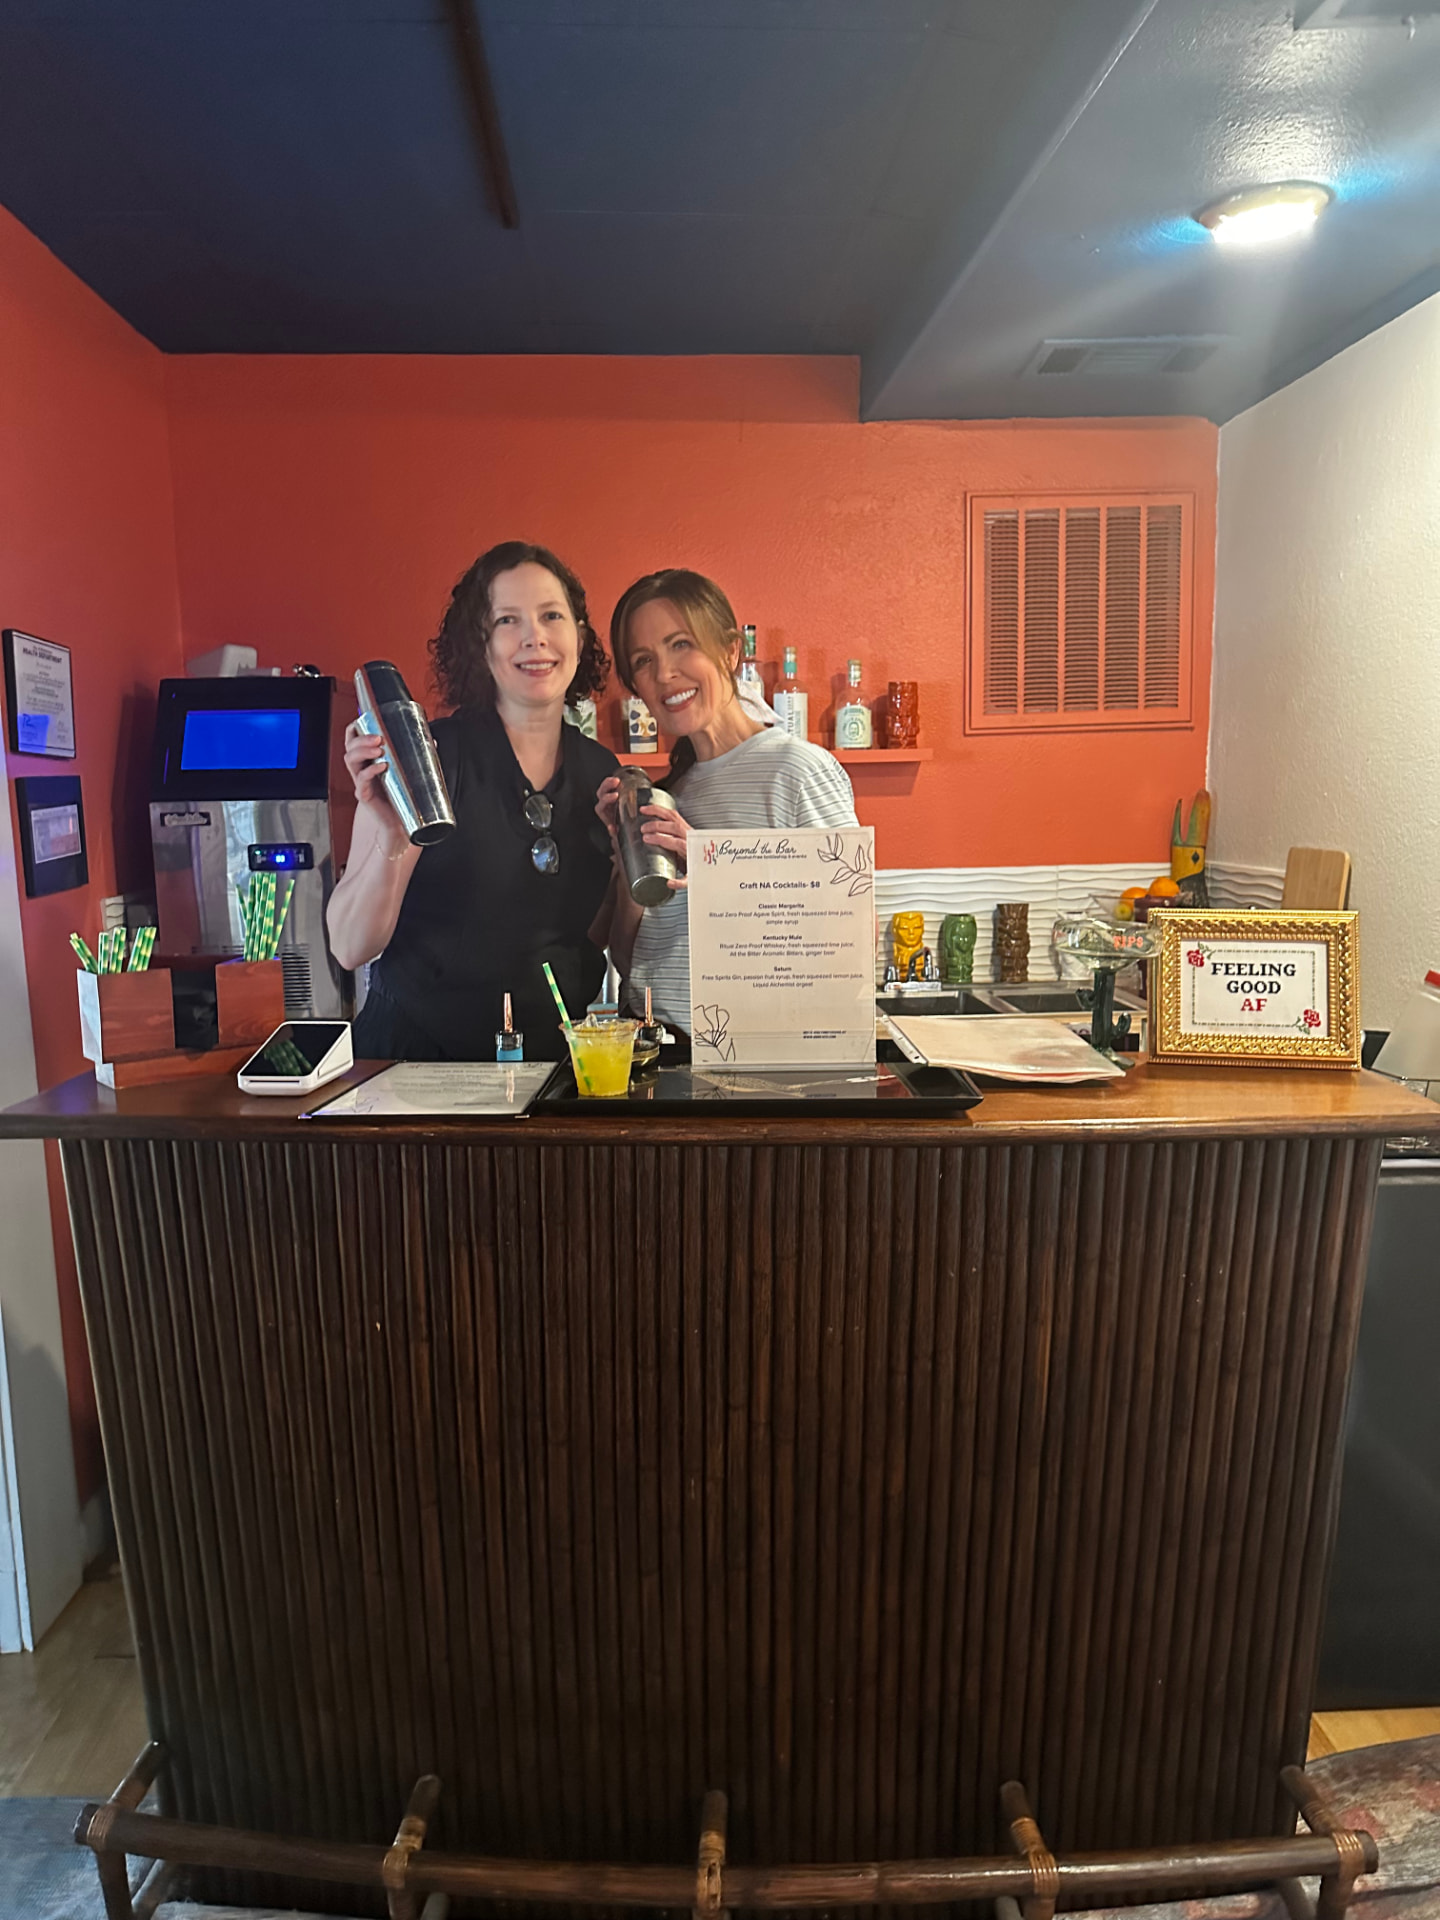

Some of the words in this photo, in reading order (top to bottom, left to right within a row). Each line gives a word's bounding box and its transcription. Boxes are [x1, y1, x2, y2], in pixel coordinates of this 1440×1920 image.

[719, 839, 760, 864] Beyond
[761, 842, 772, 854] the
[776, 839, 796, 854] Bar
[1112, 935, 1144, 949] TIPS
[1211, 962, 1296, 977] FEELING
[1226, 980, 1281, 994] GOOD
[1240, 998, 1267, 1011] AF
